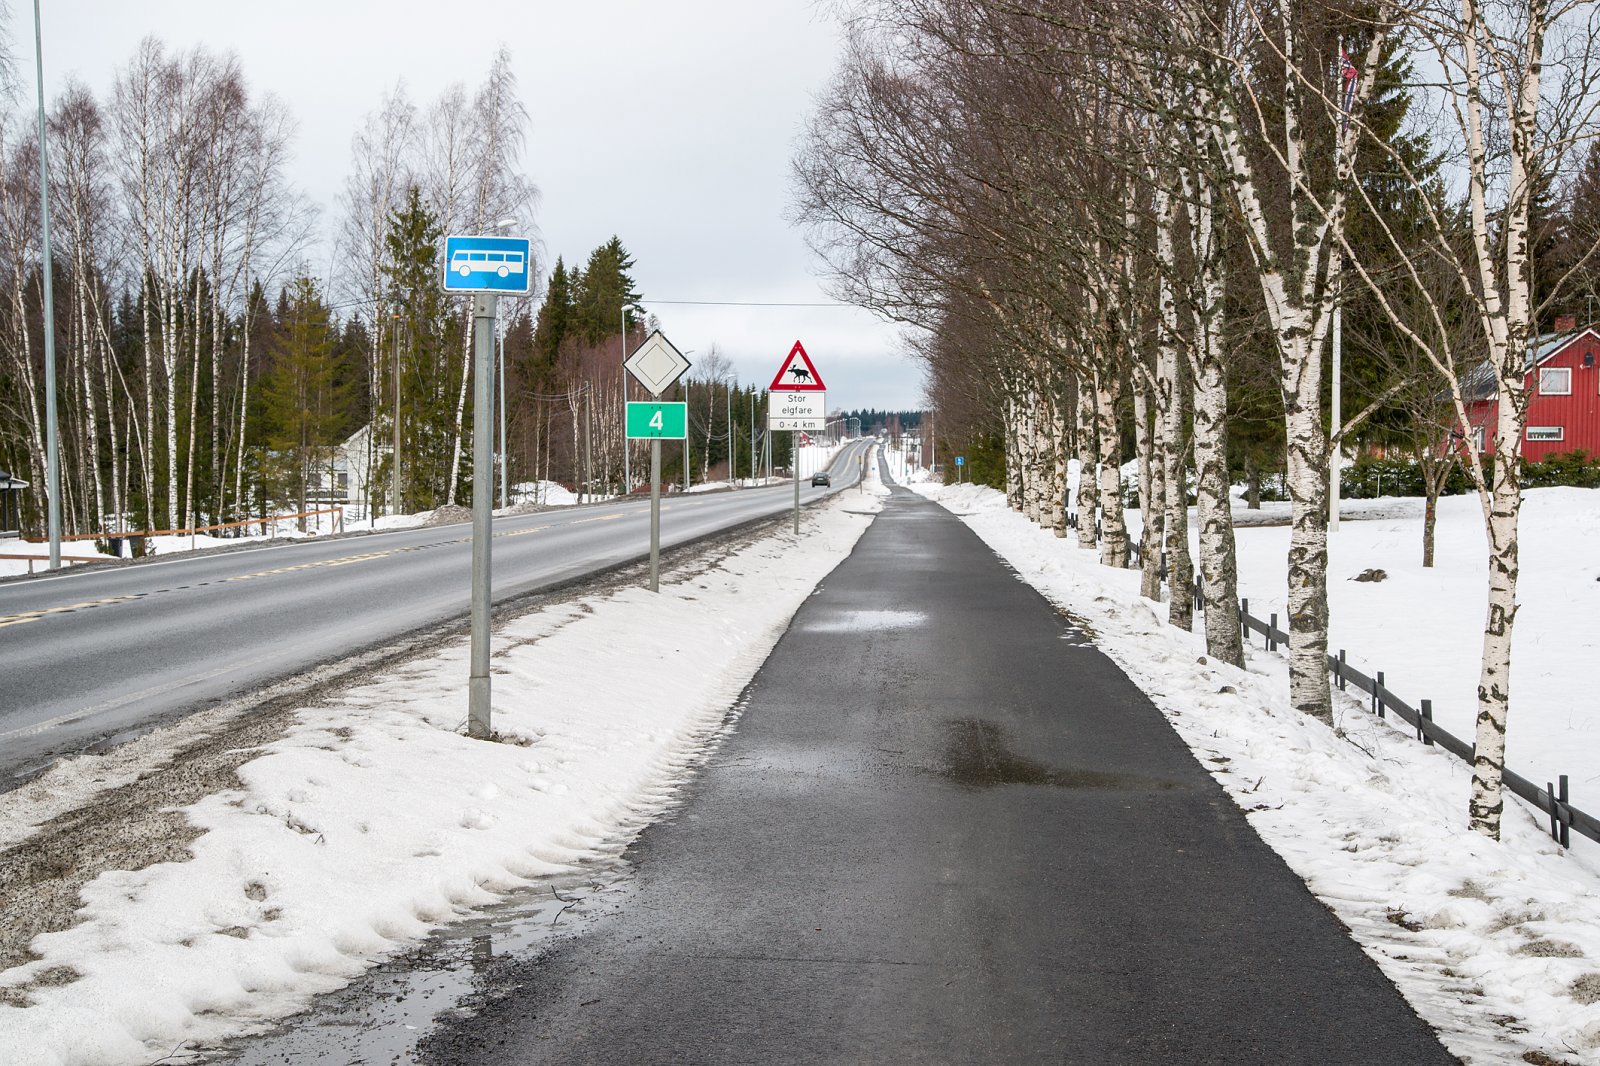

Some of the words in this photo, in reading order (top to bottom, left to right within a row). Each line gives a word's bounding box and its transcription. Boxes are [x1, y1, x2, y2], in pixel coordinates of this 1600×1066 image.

[788, 394, 806, 402] Stor
[782, 406, 812, 416] elgfare
[649, 411, 663, 430] 4
